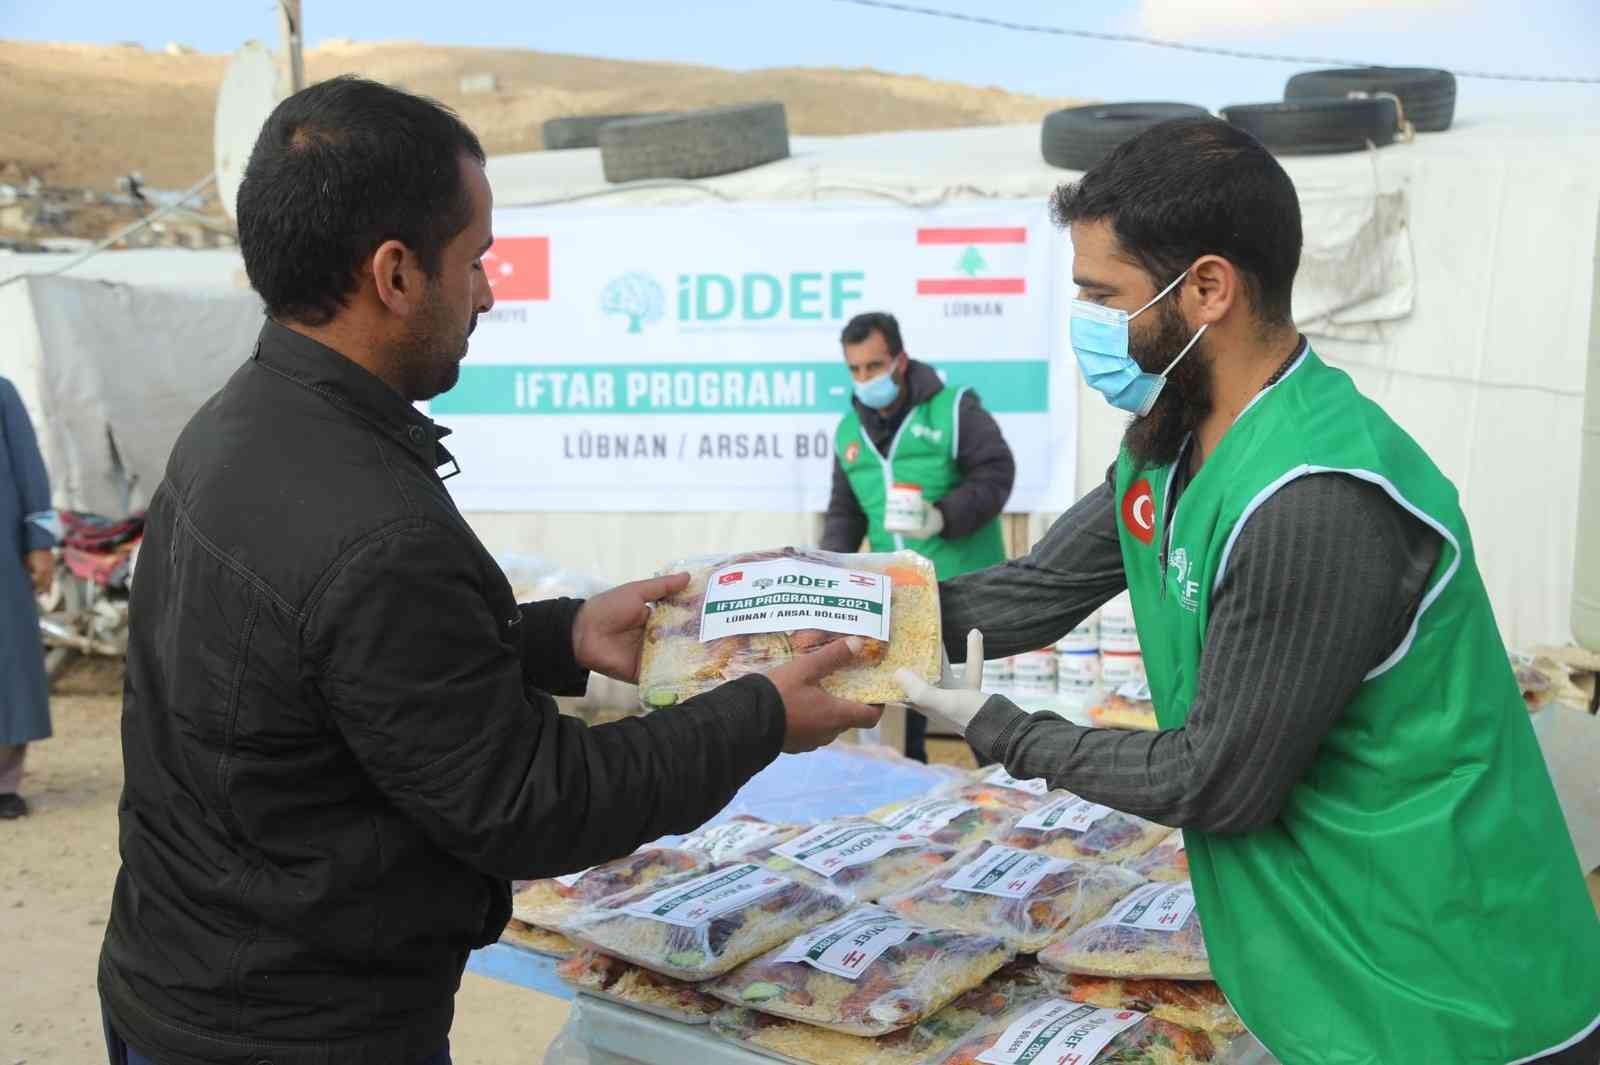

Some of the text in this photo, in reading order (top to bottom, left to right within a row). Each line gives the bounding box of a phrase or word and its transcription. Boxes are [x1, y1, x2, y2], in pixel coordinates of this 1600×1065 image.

[626, 370, 816, 408] PROGRAMI
[563, 429, 667, 460] LÜBNAN
[698, 432, 785, 460] ARSAL
[794, 427, 830, 460] BÖ
[838, 598, 871, 611] 2021
